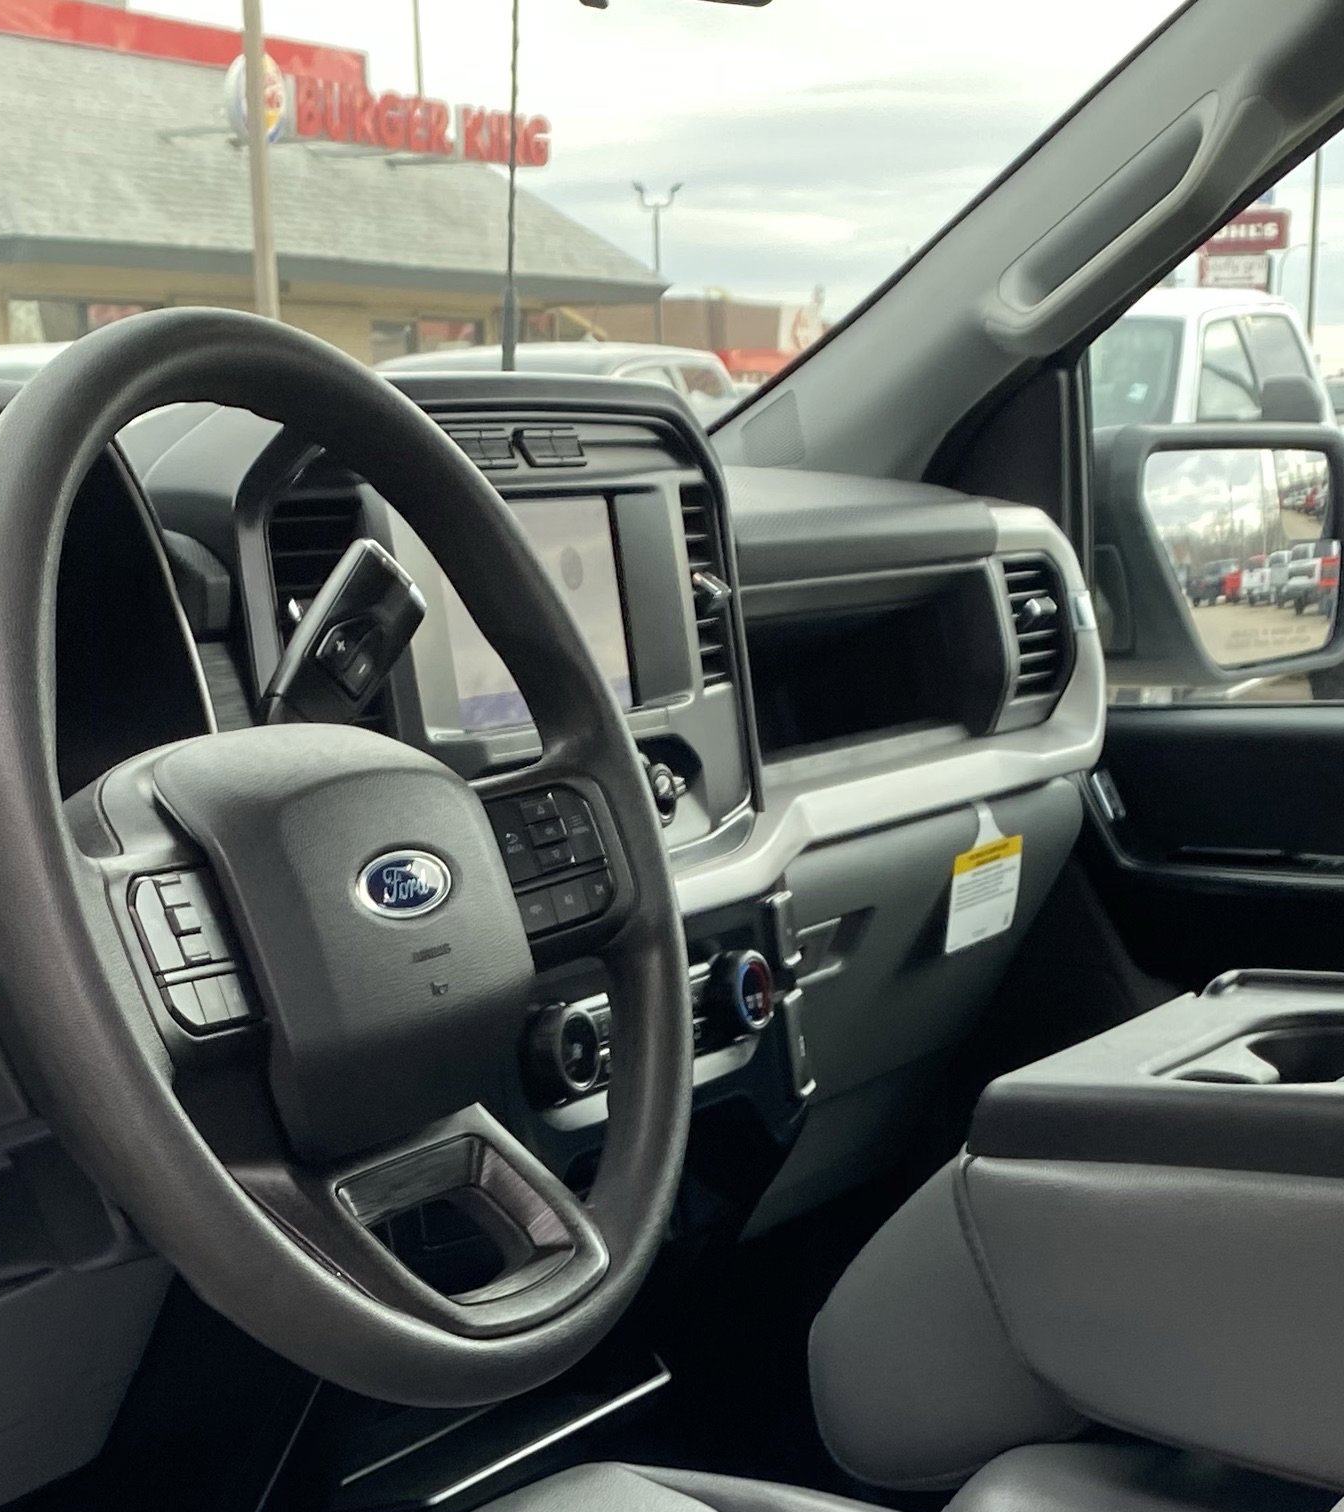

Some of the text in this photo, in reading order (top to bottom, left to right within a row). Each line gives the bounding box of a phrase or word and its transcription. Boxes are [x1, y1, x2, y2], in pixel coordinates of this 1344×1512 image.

[295, 75, 552, 166] BURGER KING
[382, 862, 430, 904] Ford
